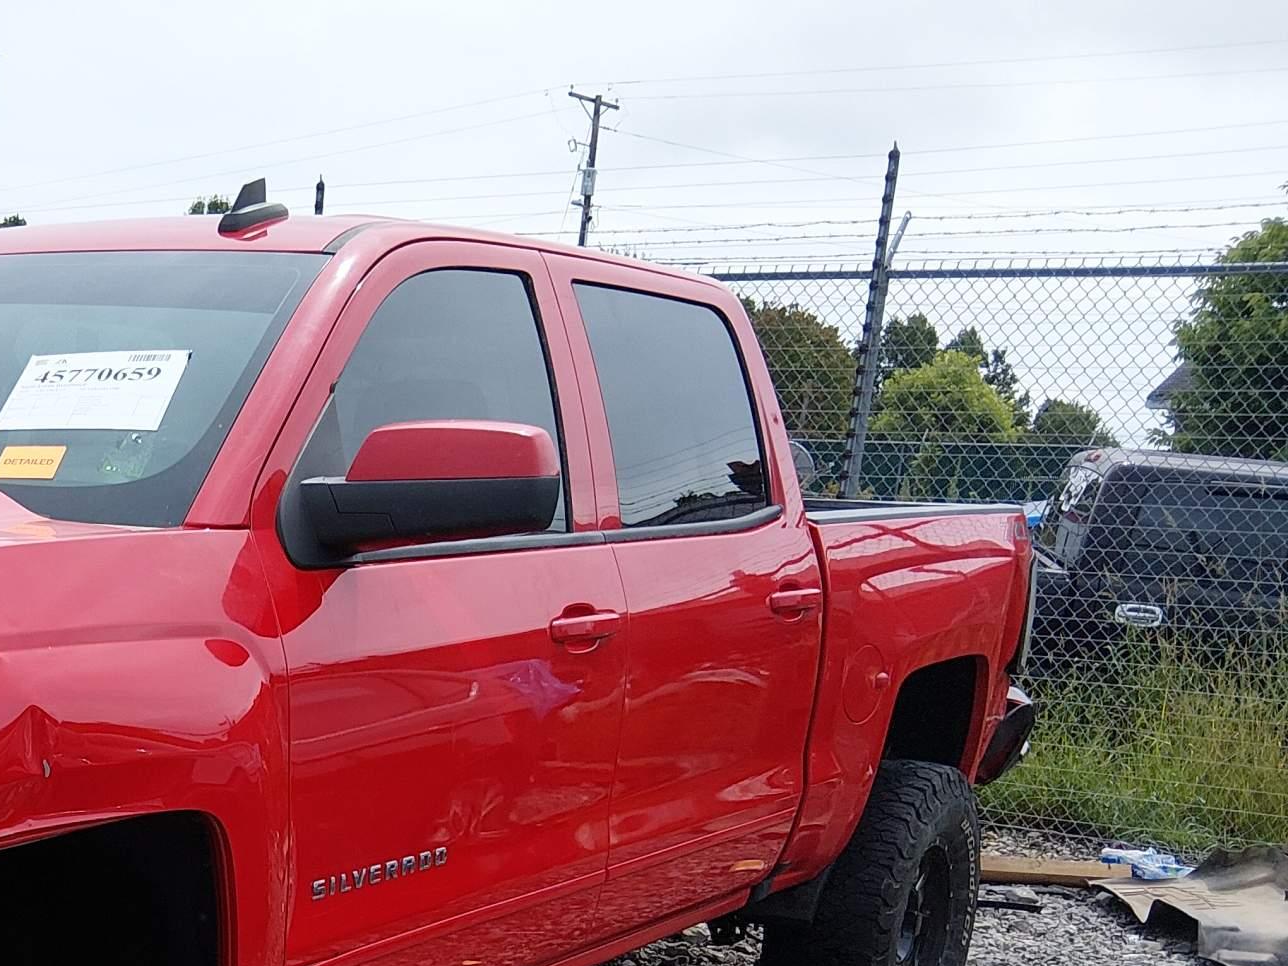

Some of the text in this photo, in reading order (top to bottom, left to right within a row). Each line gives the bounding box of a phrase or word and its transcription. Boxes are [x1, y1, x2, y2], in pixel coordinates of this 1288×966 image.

[34, 366, 162, 383] 45770659
[3, 458, 55, 466] DETAILED
[312, 847, 448, 901] SILVERADO
